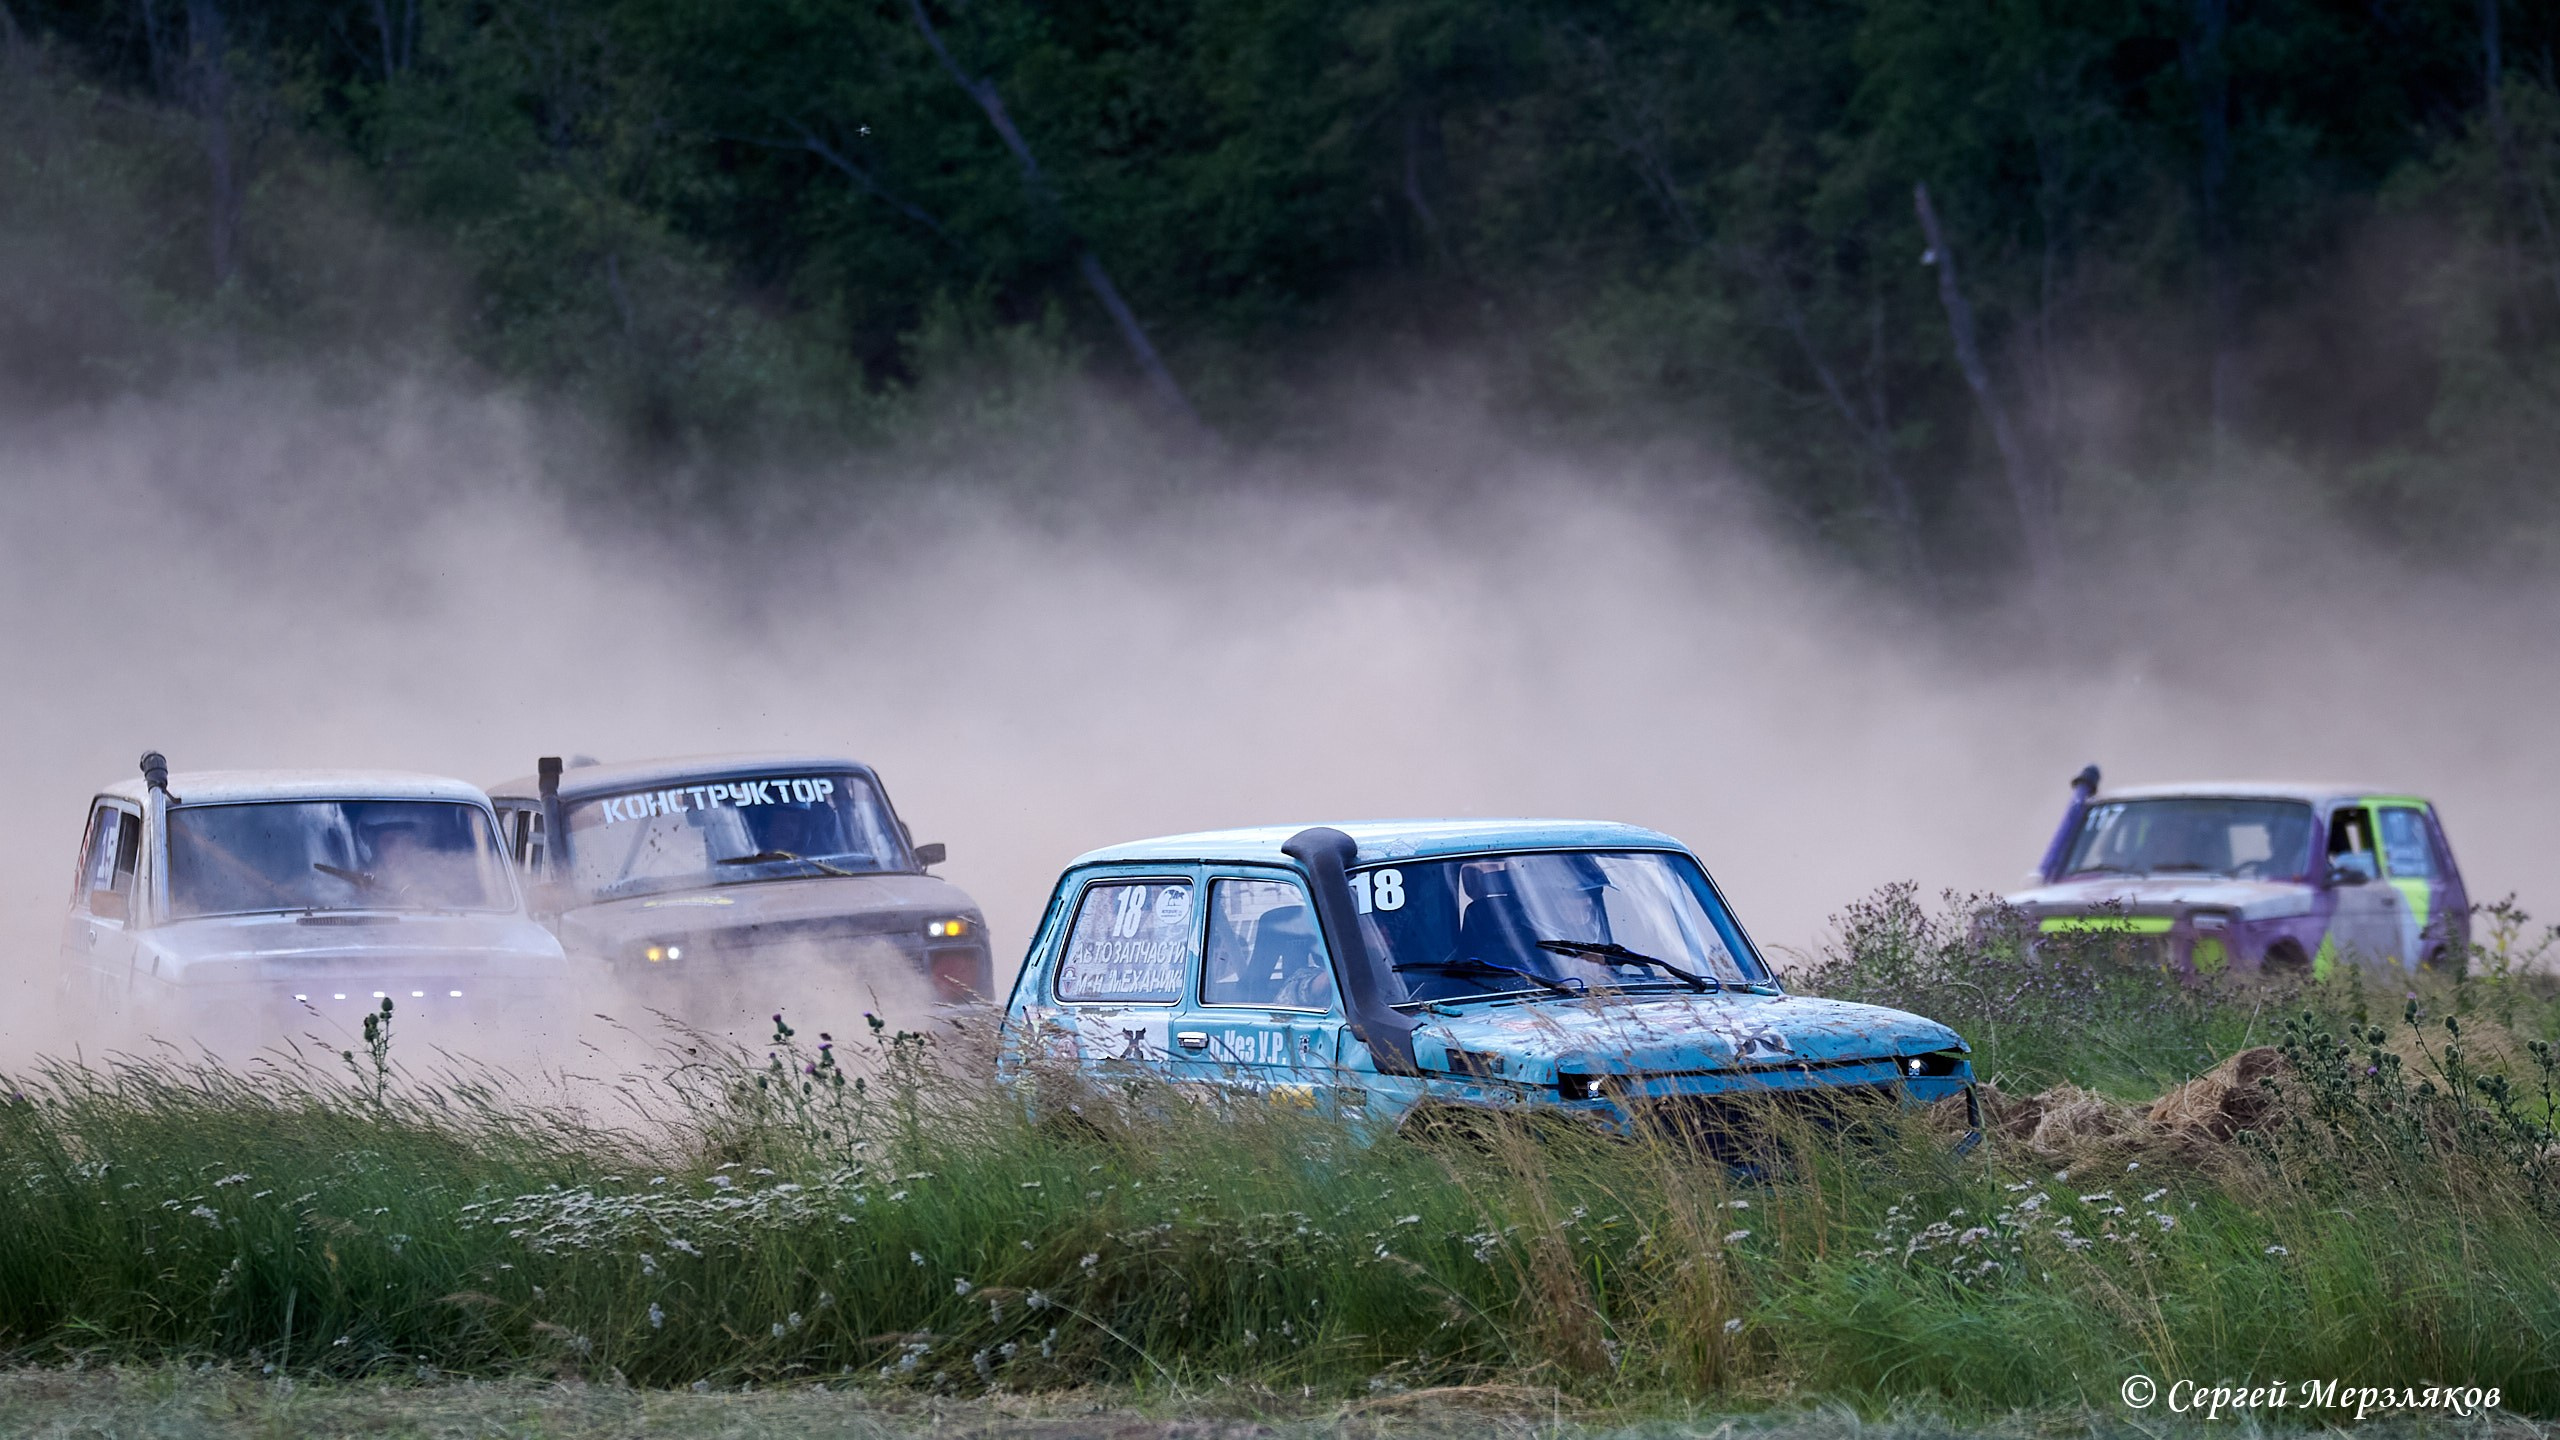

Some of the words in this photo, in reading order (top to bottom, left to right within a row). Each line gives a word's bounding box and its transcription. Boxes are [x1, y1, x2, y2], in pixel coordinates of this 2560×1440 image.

[602, 778, 834, 824] КОНСТРУКТОР
[1113, 886, 1146, 938] 18
[1348, 869, 1405, 914] 18
